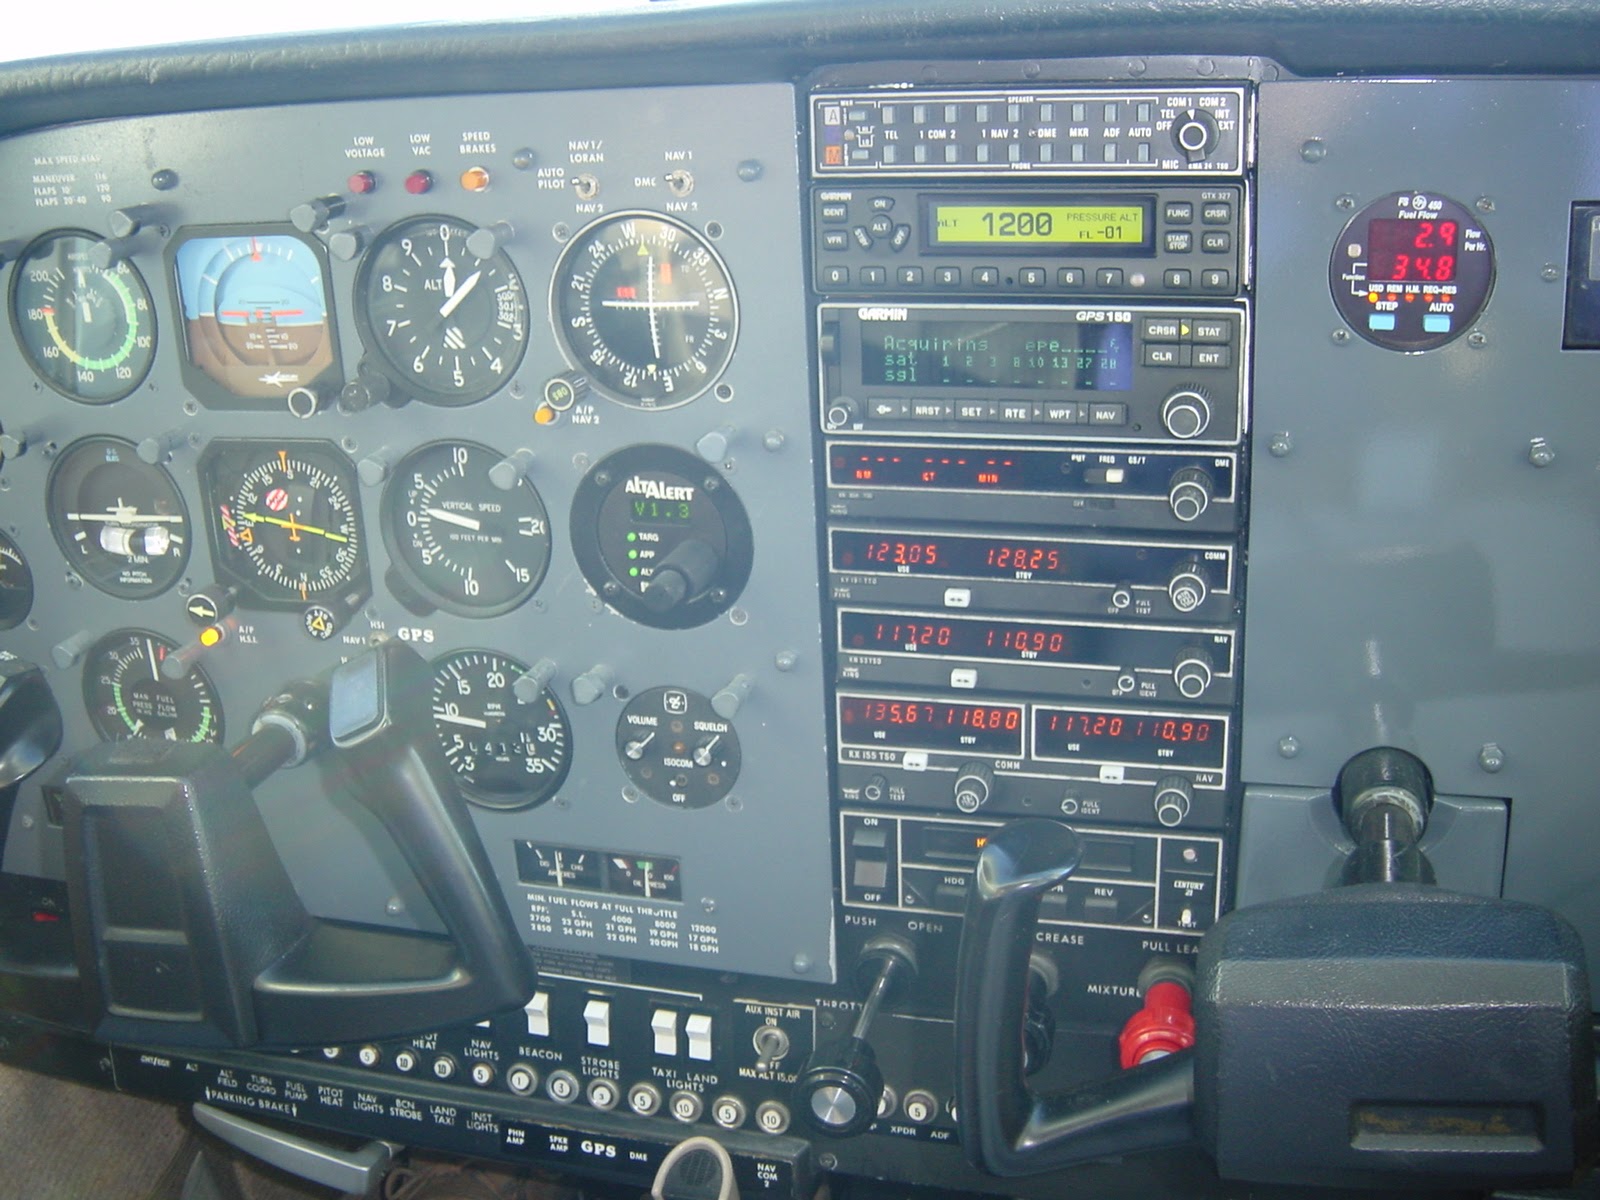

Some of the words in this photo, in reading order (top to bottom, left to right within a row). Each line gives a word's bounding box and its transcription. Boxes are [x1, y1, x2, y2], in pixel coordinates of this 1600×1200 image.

[1161, 110, 1175, 118] TEL
[1215, 110, 1229, 118] INT
[1219, 121, 1234, 130] EXT
[462, 132, 490, 141] SPEED
[885, 131, 898, 139] TEL
[1104, 128, 1120, 137] ADF
[1129, 128, 1152, 137] AUTO
[354, 137, 374, 145] LOW
[410, 134, 430, 143] LOW
[345, 148, 385, 158] VOLTAGE
[412, 147, 431, 155] VAC
[460, 144, 496, 154] BRAKES
[35, 157, 53, 165] MAX
[570, 154, 603, 162] LORAN
[1162, 160, 1178, 169] MIC
[538, 168, 564, 178] AUTO
[538, 180, 565, 189] PILOT
[1120, 213, 1138, 221] ALT
[1399, 211, 1417, 219] Fuel
[1418, 210, 1438, 219] Flow
[982, 212, 1053, 237] 1200
[621, 222, 635, 238] W
[1097, 226, 1122, 238] -01
[1414, 222, 1456, 248] 2.9
[827, 236, 842, 244] VFR
[1392, 256, 1453, 280] 34.8
[30, 271, 48, 282] 200
[382, 276, 392, 291] 8
[1369, 284, 1383, 292] USD
[1375, 302, 1398, 310] STEP
[1430, 303, 1454, 311] AUTO
[858, 308, 907, 321] GARMIN
[1076, 312, 1104, 321] GPS
[1149, 326, 1176, 335] CRSR
[1198, 328, 1220, 336] STAT
[43, 347, 59, 357] 160
[1152, 353, 1172, 361] CLR
[885, 353, 917, 366] sat
[1053, 359, 1068, 368] 13
[1077, 359, 1092, 369] 27
[1200, 354, 1218, 363] ENT
[413, 357, 423, 372] 6
[78, 371, 94, 382] 140
[453, 371, 464, 387] 5
[916, 407, 940, 415] NRST
[962, 408, 982, 416] SET
[1050, 410, 1070, 419] WPT
[1096, 411, 1115, 420] NAV
[453, 448, 467, 463] 10
[1099, 456, 1115, 464] FREQ
[414, 474, 424, 488] 5
[442, 502, 473, 511] VERTICAL
[479, 503, 501, 512] SPEED
[340, 525, 348, 533] W
[422, 550, 431, 564] 5
[986, 548, 1059, 570] 128.25
[1205, 552, 1226, 560] COMM
[465, 580, 478, 595] 10
[370, 621, 384, 629] HSI
[398, 627, 434, 643] GPS
[876, 625, 950, 646] 117.20
[987, 630, 1063, 652] 110.90
[487, 673, 505, 687] 20
[457, 680, 470, 695] 15
[627, 715, 657, 726] VOLUME
[865, 704, 934, 723] 135.67
[948, 709, 1017, 729] 118.80
[694, 722, 727, 732] SQUELCH
[1051, 716, 1122, 735] 117.20
[1137, 722, 1209, 741] 110.90
[537, 727, 556, 742] 30
[454, 735, 464, 749] 5
[526, 759, 544, 773] 35
[664, 758, 693, 768] ISOCOM
[944, 877, 964, 885] HDG
[1174, 881, 1204, 890] CENTURY
[1094, 888, 1113, 896] REV
[527, 894, 546, 902] MIN.
[549, 896, 567, 905] FUEL
[571, 899, 598, 909] FLOWS
[615, 905, 633, 913] FULL
[637, 907, 677, 918] THROTTLE
[845, 916, 876, 925] PUSH
[530, 914, 550, 923] 2700
[574, 920, 592, 928] GPH
[606, 923, 614, 931] 21
[618, 925, 636, 934] GPH
[660, 930, 677, 939] GPH
[700, 936, 717, 944] GPH
[908, 921, 943, 932] OPEN
[1143, 941, 1170, 952] PULL
[745, 1005, 762, 1014] AUX
[765, 1007, 782, 1016] INST
[786, 1010, 800, 1019] AIR
[471, 1040, 491, 1048] NAV
[464, 1048, 499, 1060] LIGHTS
[519, 1047, 562, 1061] BEACON
[581, 1057, 620, 1070] STROBE
[583, 1067, 619, 1079] LIGHTS
[652, 1067, 676, 1078] TAXI
[687, 1073, 718, 1085] LAND
[218, 1077, 237, 1087] FIELD
[667, 1080, 704, 1092] LIGHTS
[318, 1087, 343, 1097] PITOT
[211, 1090, 254, 1106] PARKING
[258, 1099, 290, 1113] BRAKE
[354, 1102, 383, 1114] LIGHTS
[430, 1105, 456, 1117] LAND
[467, 1122, 498, 1133] LIGHTS
[891, 1126, 916, 1135] XPDR
[581, 1140, 616, 1157] GPS
[758, 1163, 775, 1173] NAV
